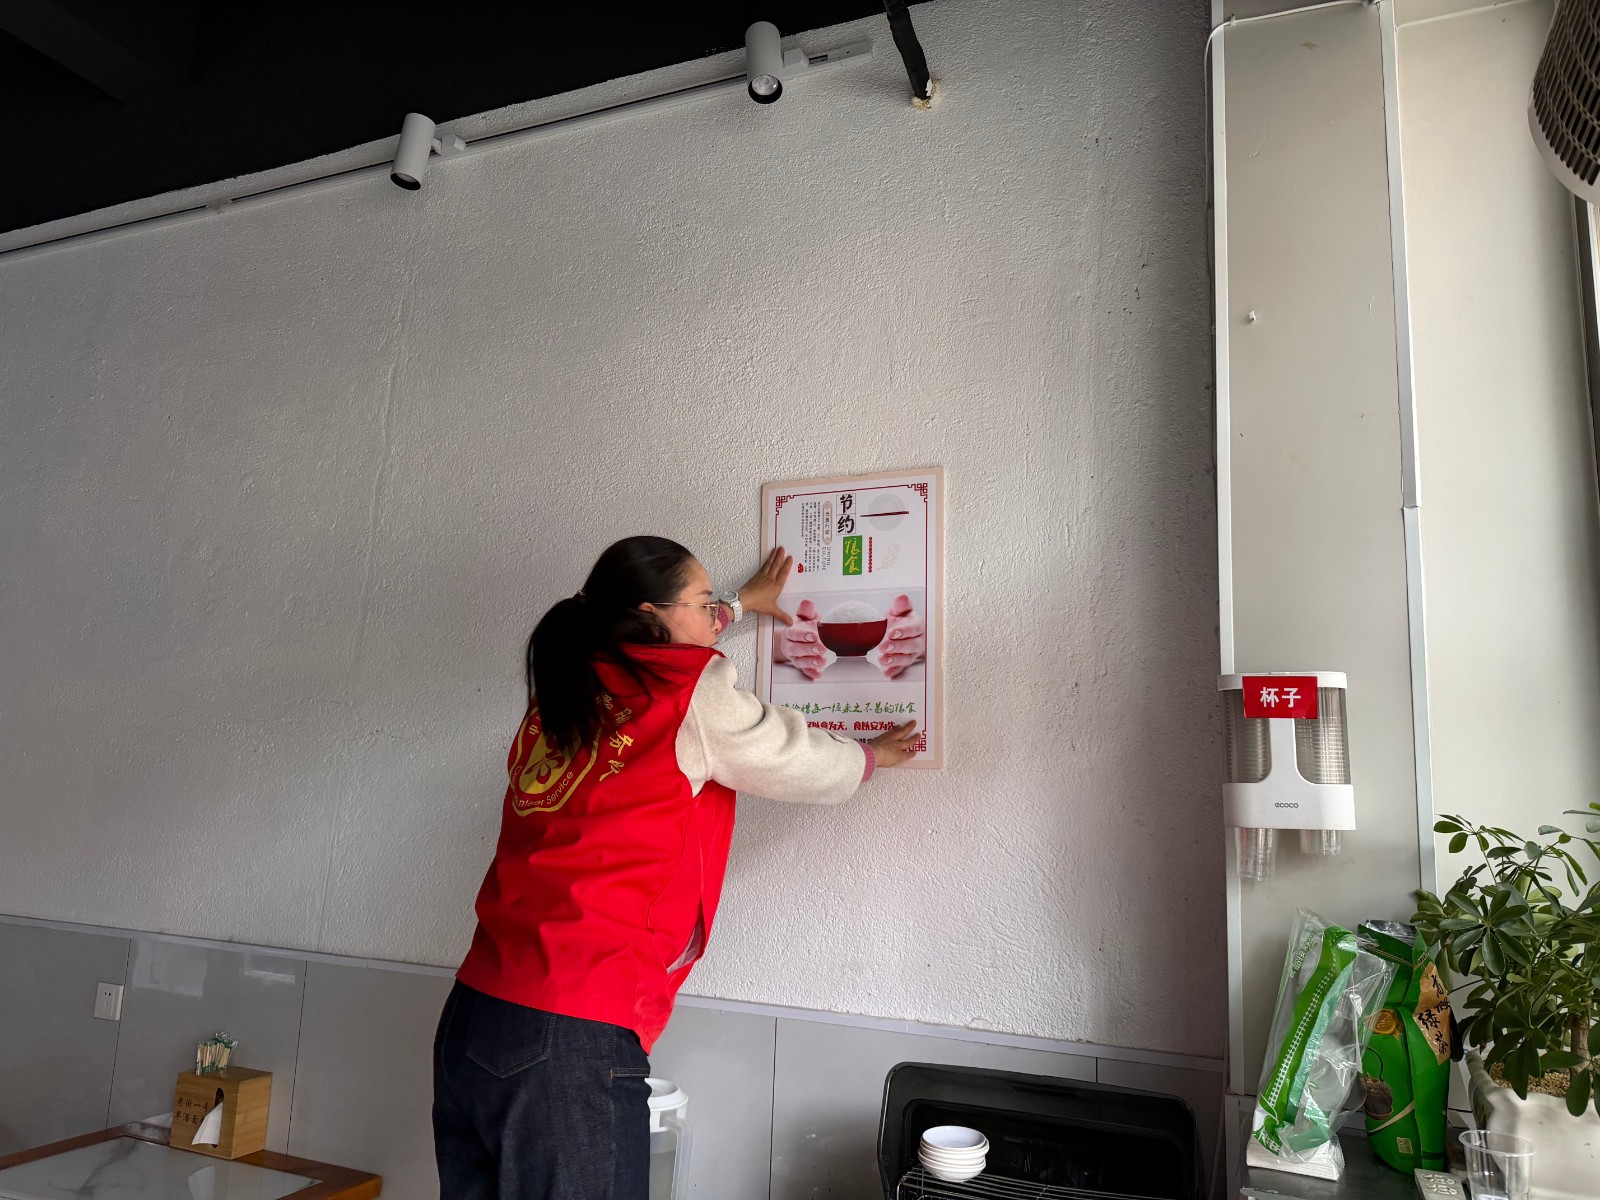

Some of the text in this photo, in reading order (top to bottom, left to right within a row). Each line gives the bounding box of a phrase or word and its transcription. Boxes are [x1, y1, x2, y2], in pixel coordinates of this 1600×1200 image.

[837, 493, 855, 534] 节约
[844, 537, 862, 574] 粮食
[1259, 686, 1302, 708] 杯子
